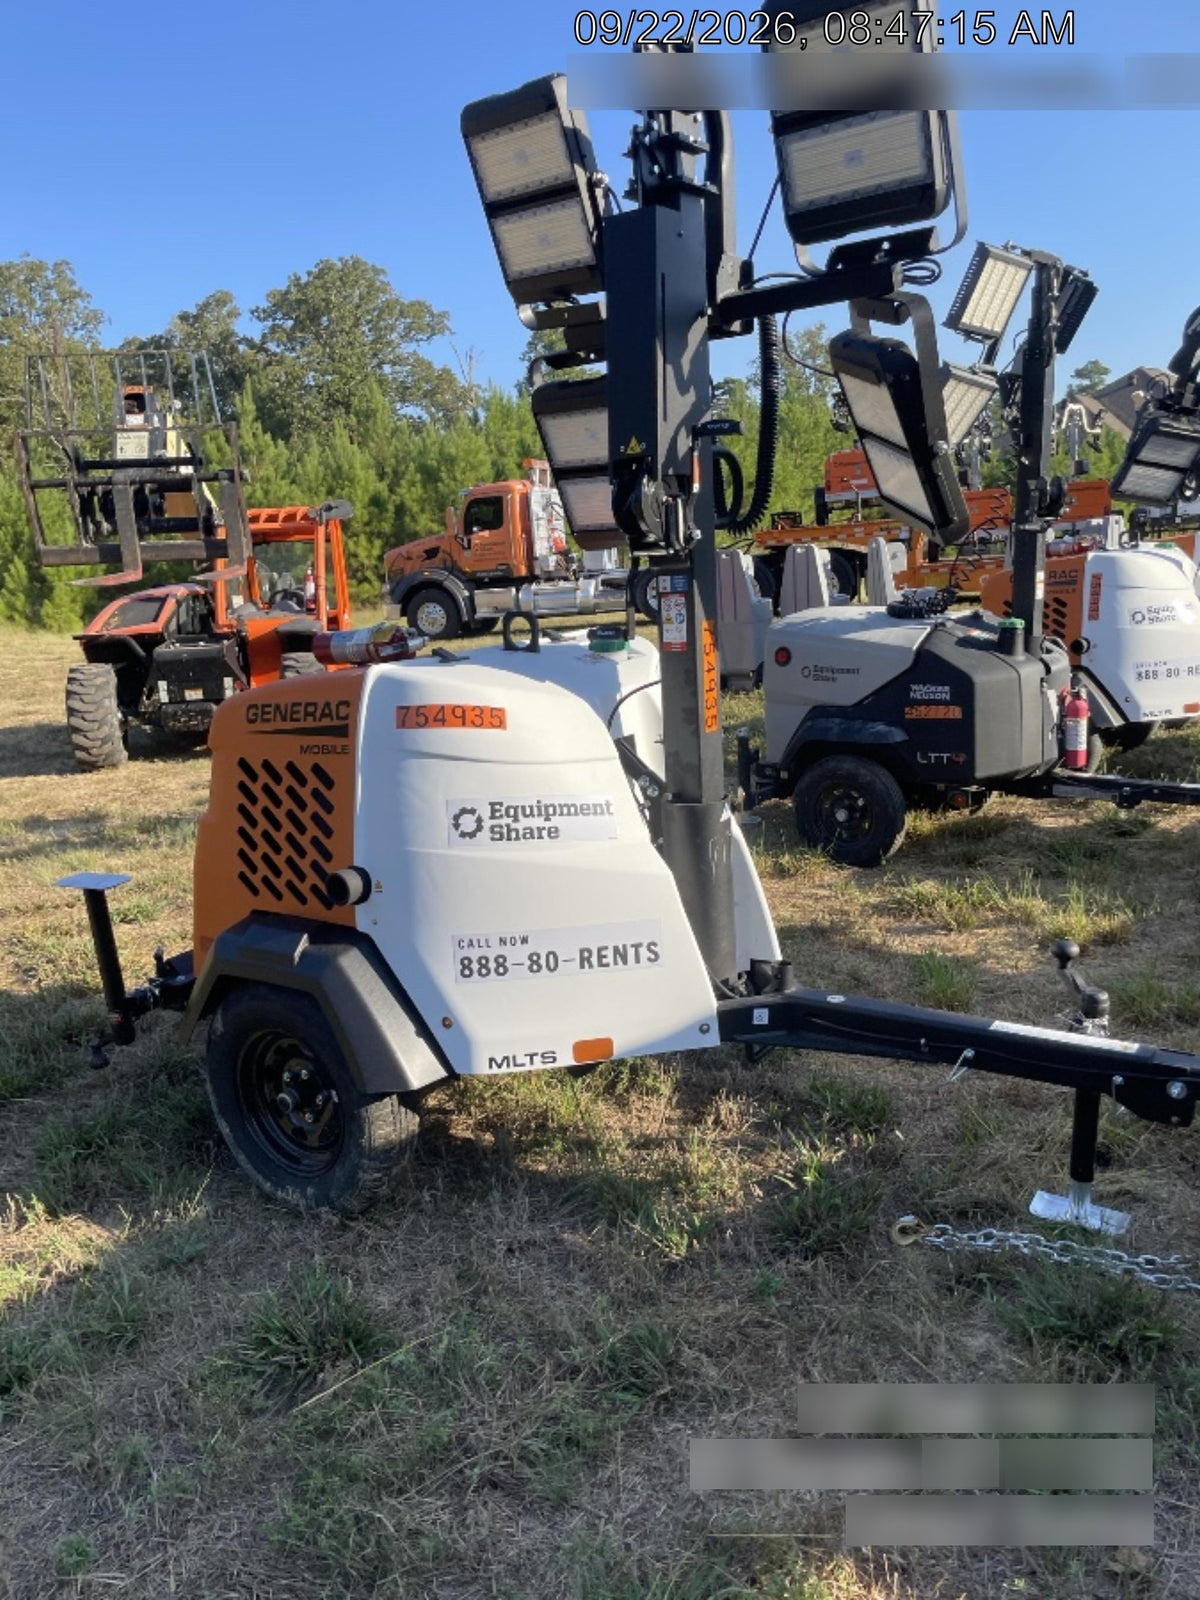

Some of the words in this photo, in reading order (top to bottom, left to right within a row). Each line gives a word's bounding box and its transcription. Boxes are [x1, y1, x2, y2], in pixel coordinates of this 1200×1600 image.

[703, 624, 718, 729] 754935
[1135, 664, 1200, 681] 888-80-RE
[245, 700, 351, 725] GENERAC
[398, 704, 505, 730] 754935
[299, 743, 351, 756] MOBILE
[488, 799, 613, 823] Equipment
[488, 822, 561, 842] Share
[457, 937, 493, 950] CALL
[498, 934, 530, 948] NOW
[459, 941, 660, 979] 888-80-RENTS
[487, 1050, 558, 1070] MLTS
